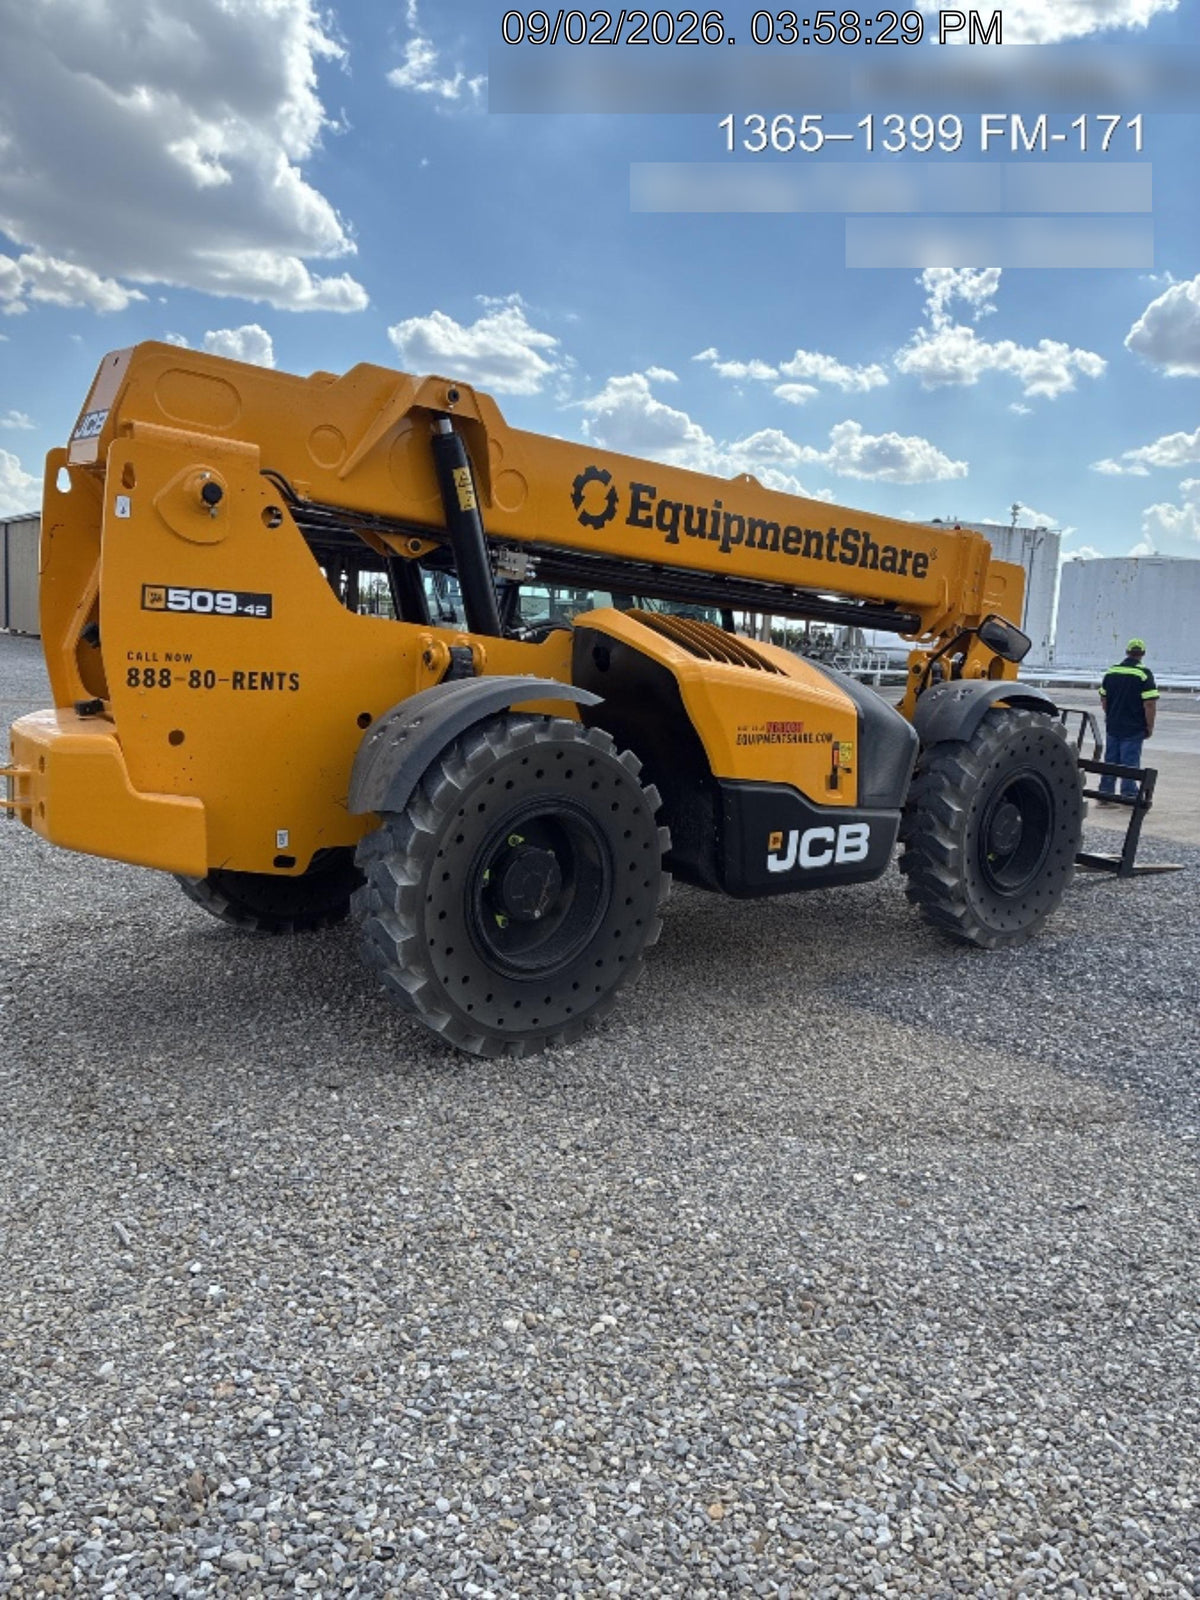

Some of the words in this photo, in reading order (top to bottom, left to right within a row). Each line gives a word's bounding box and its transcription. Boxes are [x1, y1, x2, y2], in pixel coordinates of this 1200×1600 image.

[626, 482, 929, 578] EquipmentShare
[127, 651, 158, 662] CALL
[165, 653, 192, 662] NOW
[126, 667, 300, 691] 888-80-RENTS
[767, 822, 870, 873] JCB
